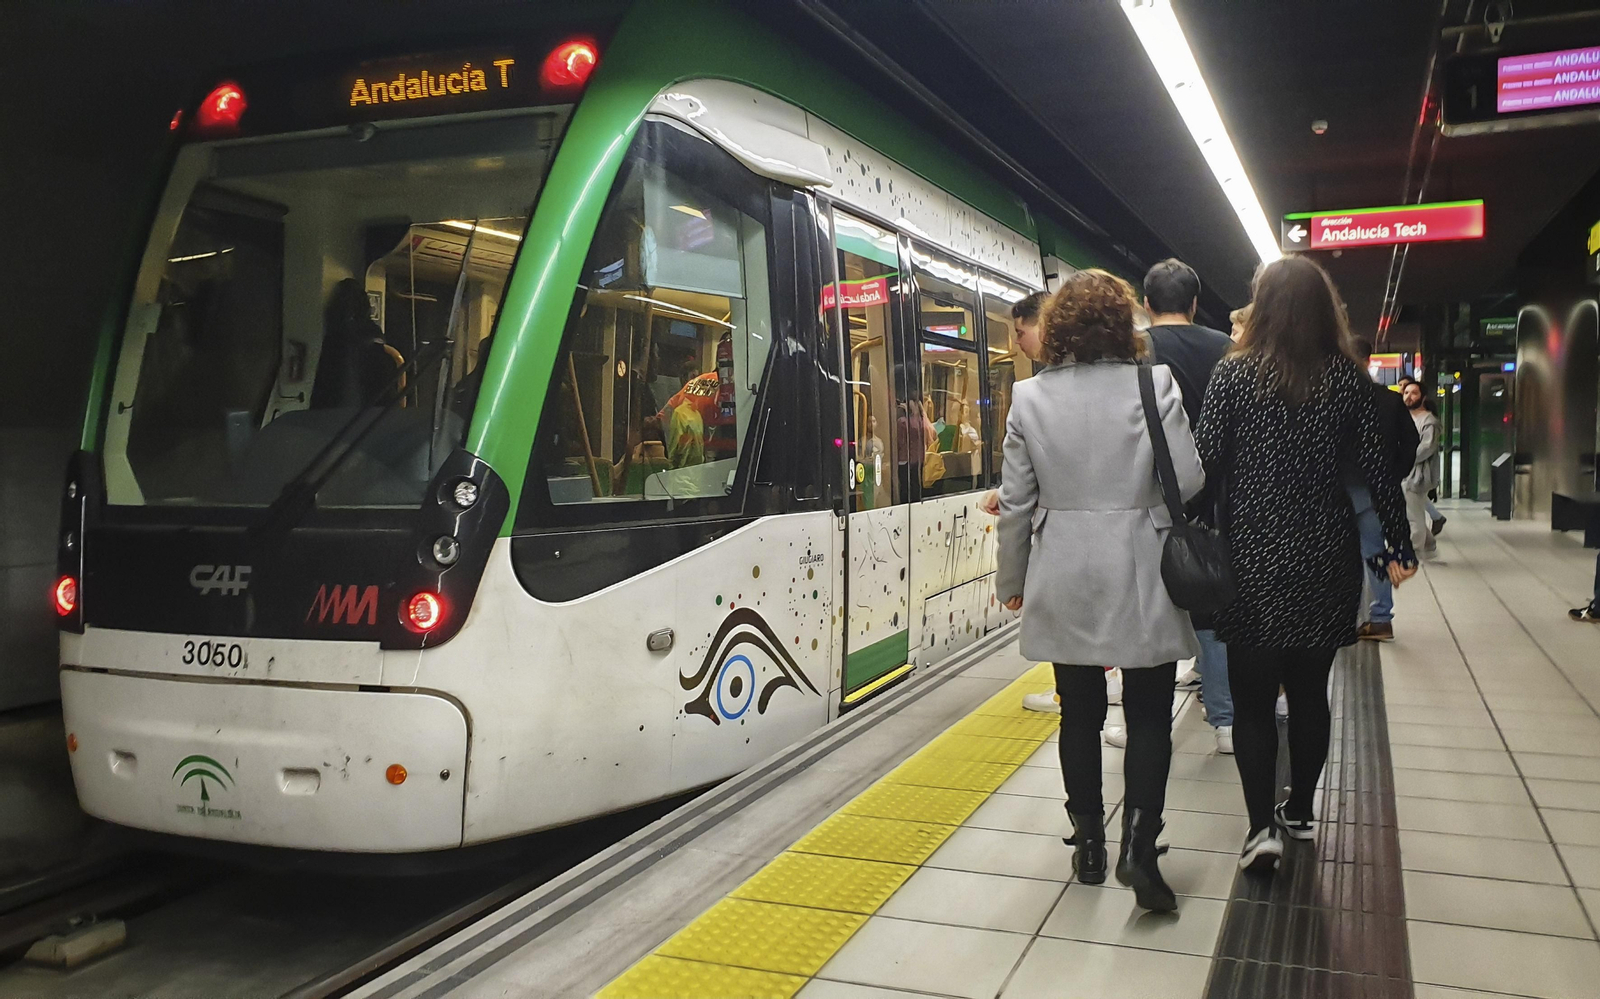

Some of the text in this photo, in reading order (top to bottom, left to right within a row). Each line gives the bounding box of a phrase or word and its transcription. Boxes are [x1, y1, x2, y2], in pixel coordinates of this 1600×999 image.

[1554, 51, 1600, 67] ANDALU
[350, 59, 515, 107] Andalucía T
[1554, 69, 1600, 85] ANDALU
[1554, 86, 1600, 103] ANDALU
[1321, 222, 1427, 242] Andalucía Tech
[190, 565, 252, 596] CAF
[183, 640, 242, 668] 3050
